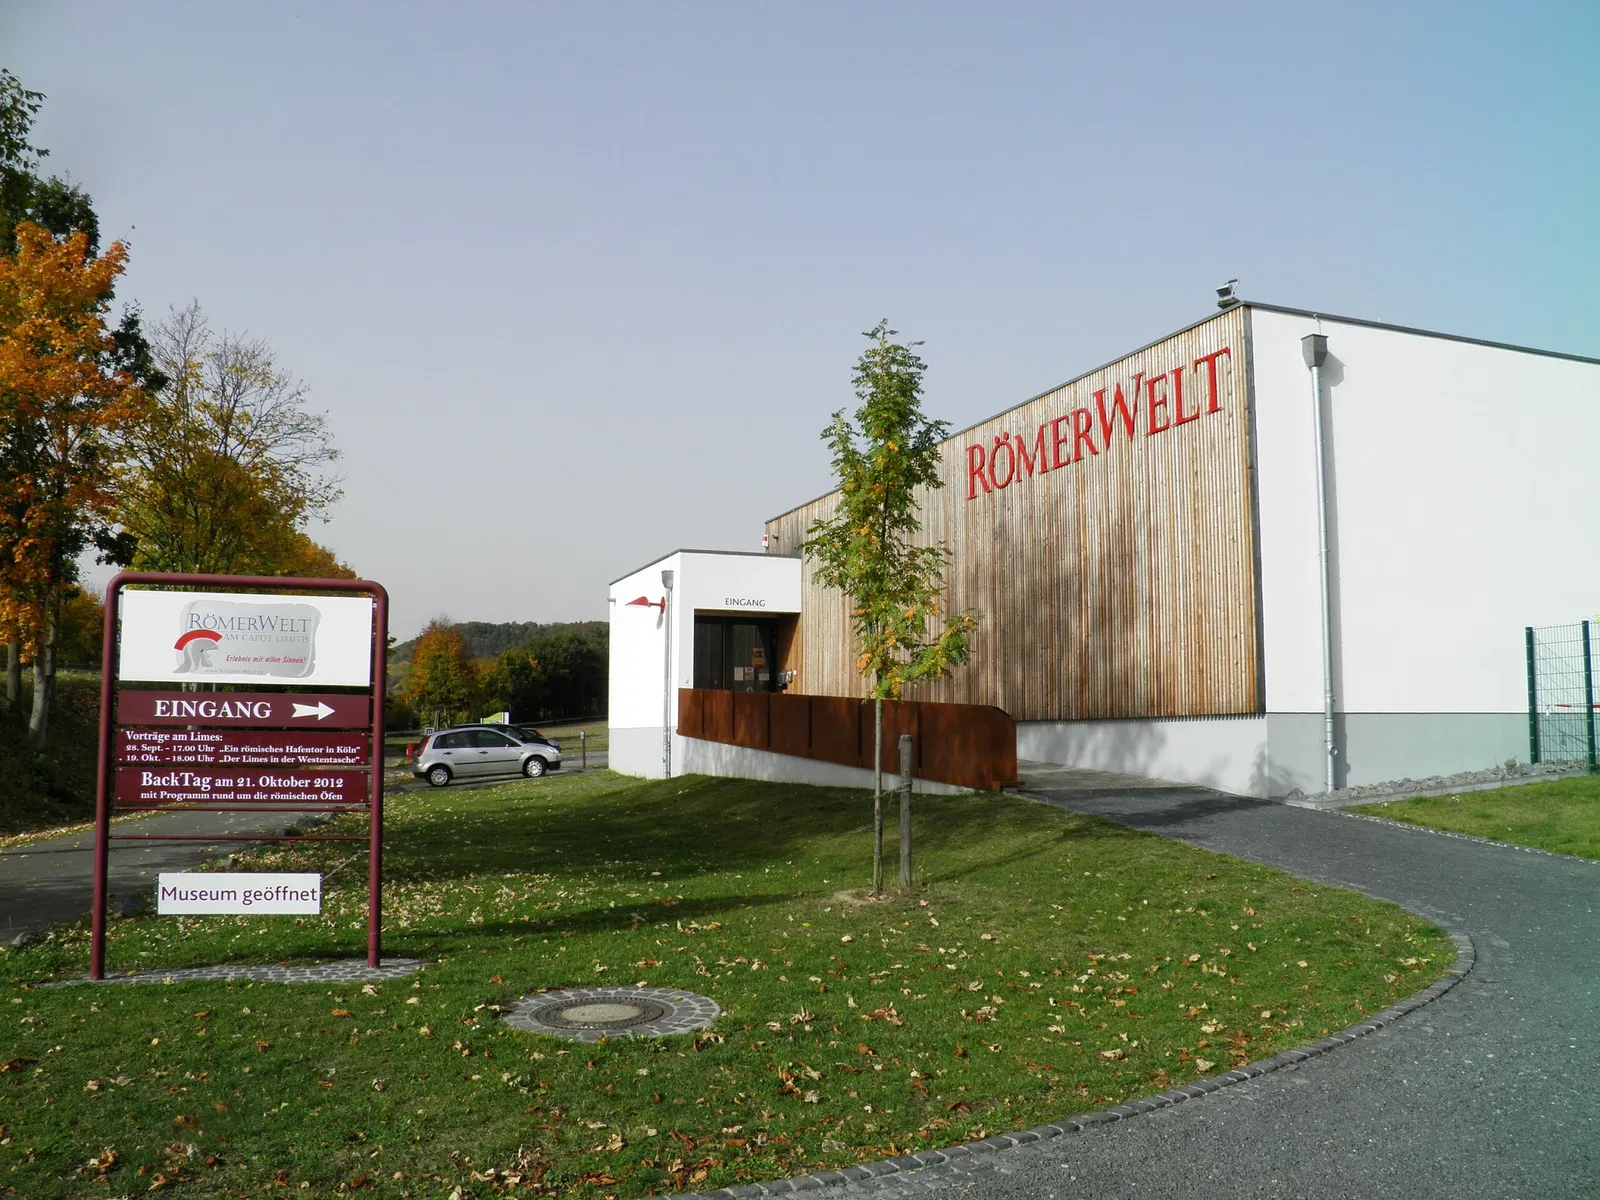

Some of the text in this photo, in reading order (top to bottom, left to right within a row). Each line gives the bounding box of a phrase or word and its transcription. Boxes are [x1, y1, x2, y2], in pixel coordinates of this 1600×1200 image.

[966, 346, 1232, 500] RÖMERWELT
[725, 598, 766, 608] EINGANG
[188, 612, 311, 632] RÖMERWELT
[224, 633, 309, 643] AM CAPUT LIMITIS
[282, 656, 306, 664] Sinnen!
[154, 700, 272, 718] EINGANG
[126, 730, 170, 744] Vorträge
[190, 732, 223, 742] Limes:
[142, 744, 164, 754] Sept.
[219, 744, 238, 753] „Ein
[286, 746, 324, 754] Hafentor
[141, 772, 344, 791] BackTag am 21. Oktober 2012
[160, 791, 210, 801] Programm
[212, 792, 234, 800] rund
[254, 792, 268, 800] die
[270, 792, 318, 800] römischen
[320, 791, 343, 800] Öfen
[162, 886, 318, 906] Museum geöffnet
